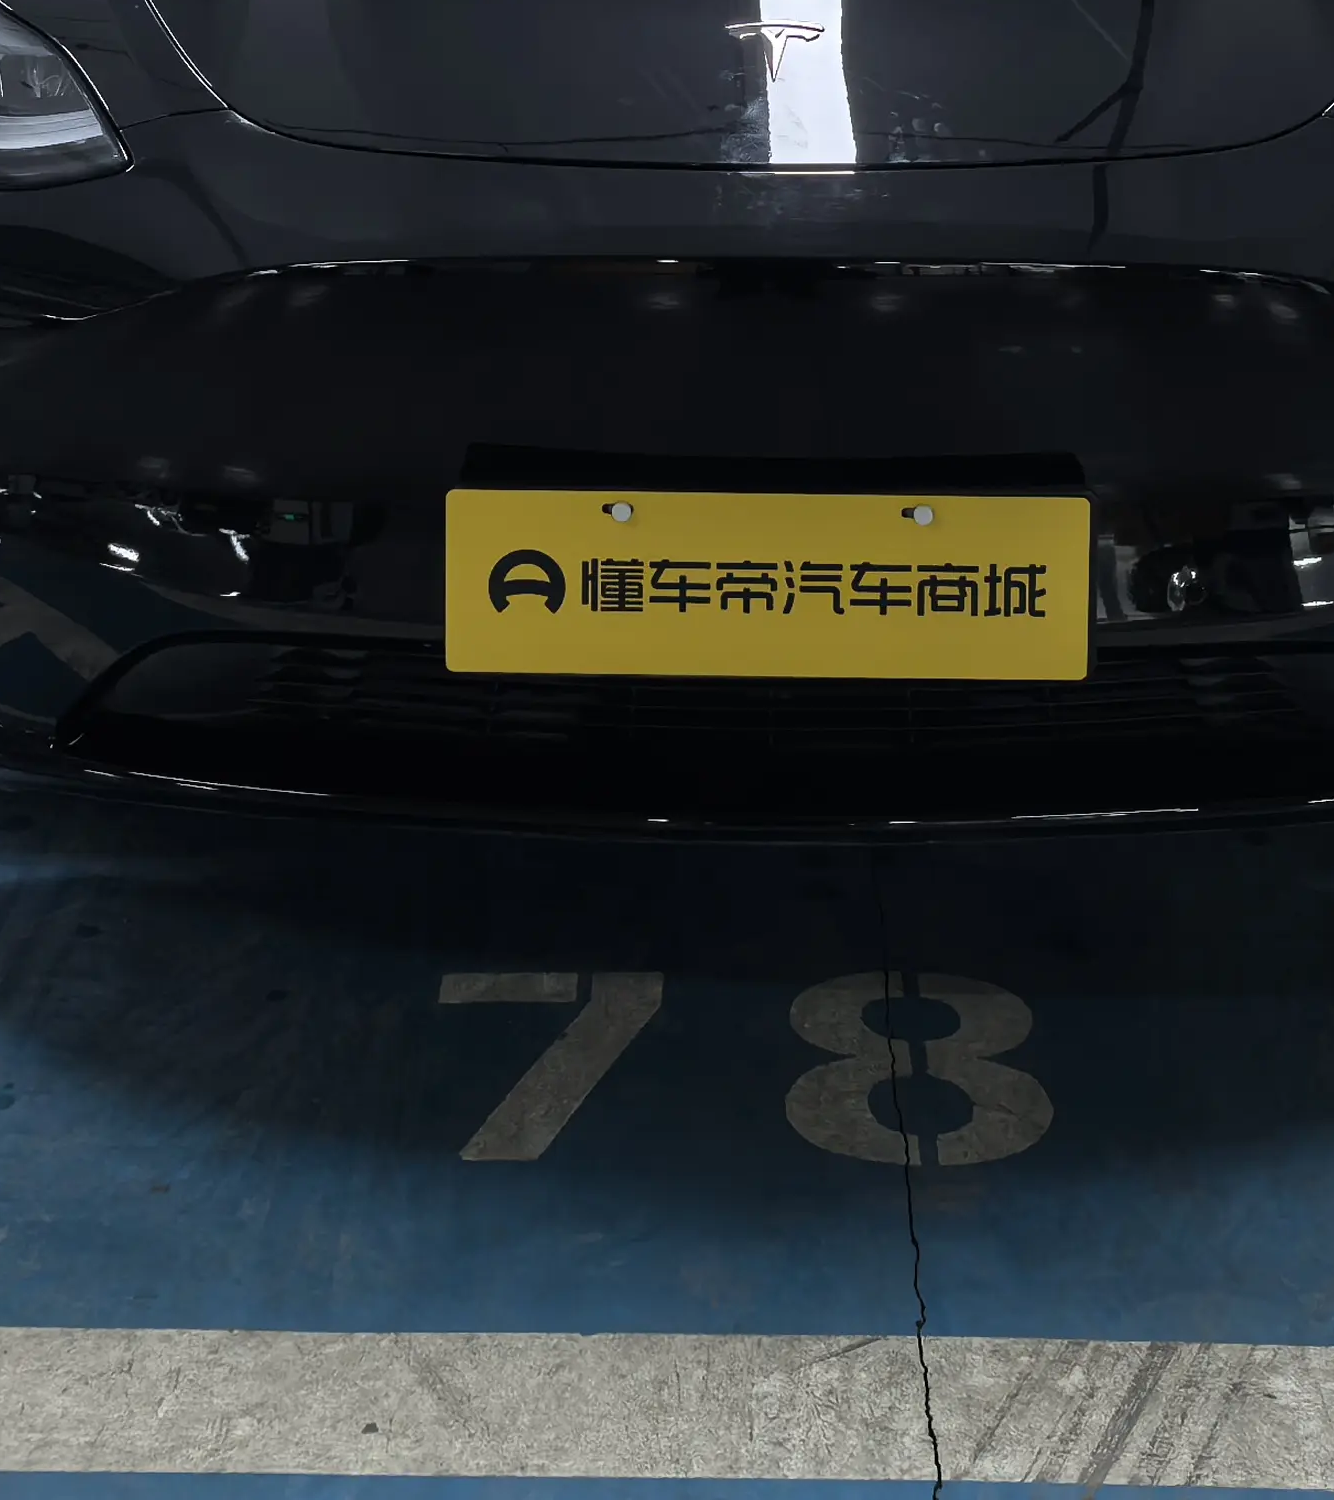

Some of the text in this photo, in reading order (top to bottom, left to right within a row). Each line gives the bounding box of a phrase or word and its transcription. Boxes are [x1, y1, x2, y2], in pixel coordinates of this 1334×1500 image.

[581, 558, 1047, 618] 懂车帝汽车商城
